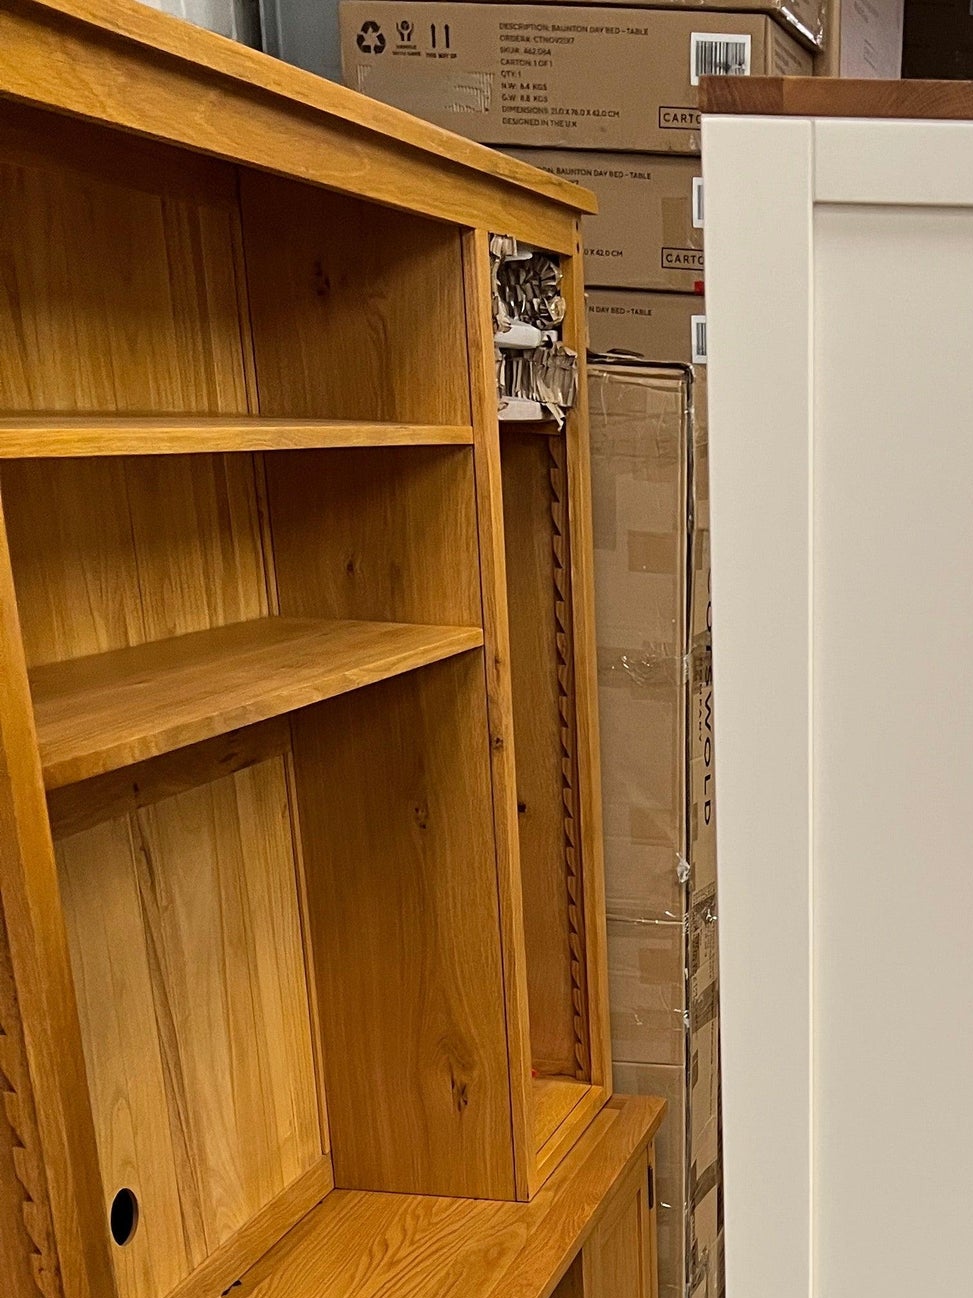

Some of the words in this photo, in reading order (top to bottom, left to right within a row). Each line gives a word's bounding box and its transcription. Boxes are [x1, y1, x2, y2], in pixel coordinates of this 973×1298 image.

[551, 24, 588, 33] BAUNTON
[626, 27, 649, 36] TABLE
[550, 119, 565, 127] THE
[556, 167, 592, 176] BAUNTON
[593, 169, 608, 178] DAY
[609, 170, 624, 178] BED
[629, 172, 652, 180] TABLE
[611, 249, 623, 257] CM
[595, 306, 609, 314] DAY
[610, 307, 626, 315] BED
[631, 308, 652, 316] TABLE
